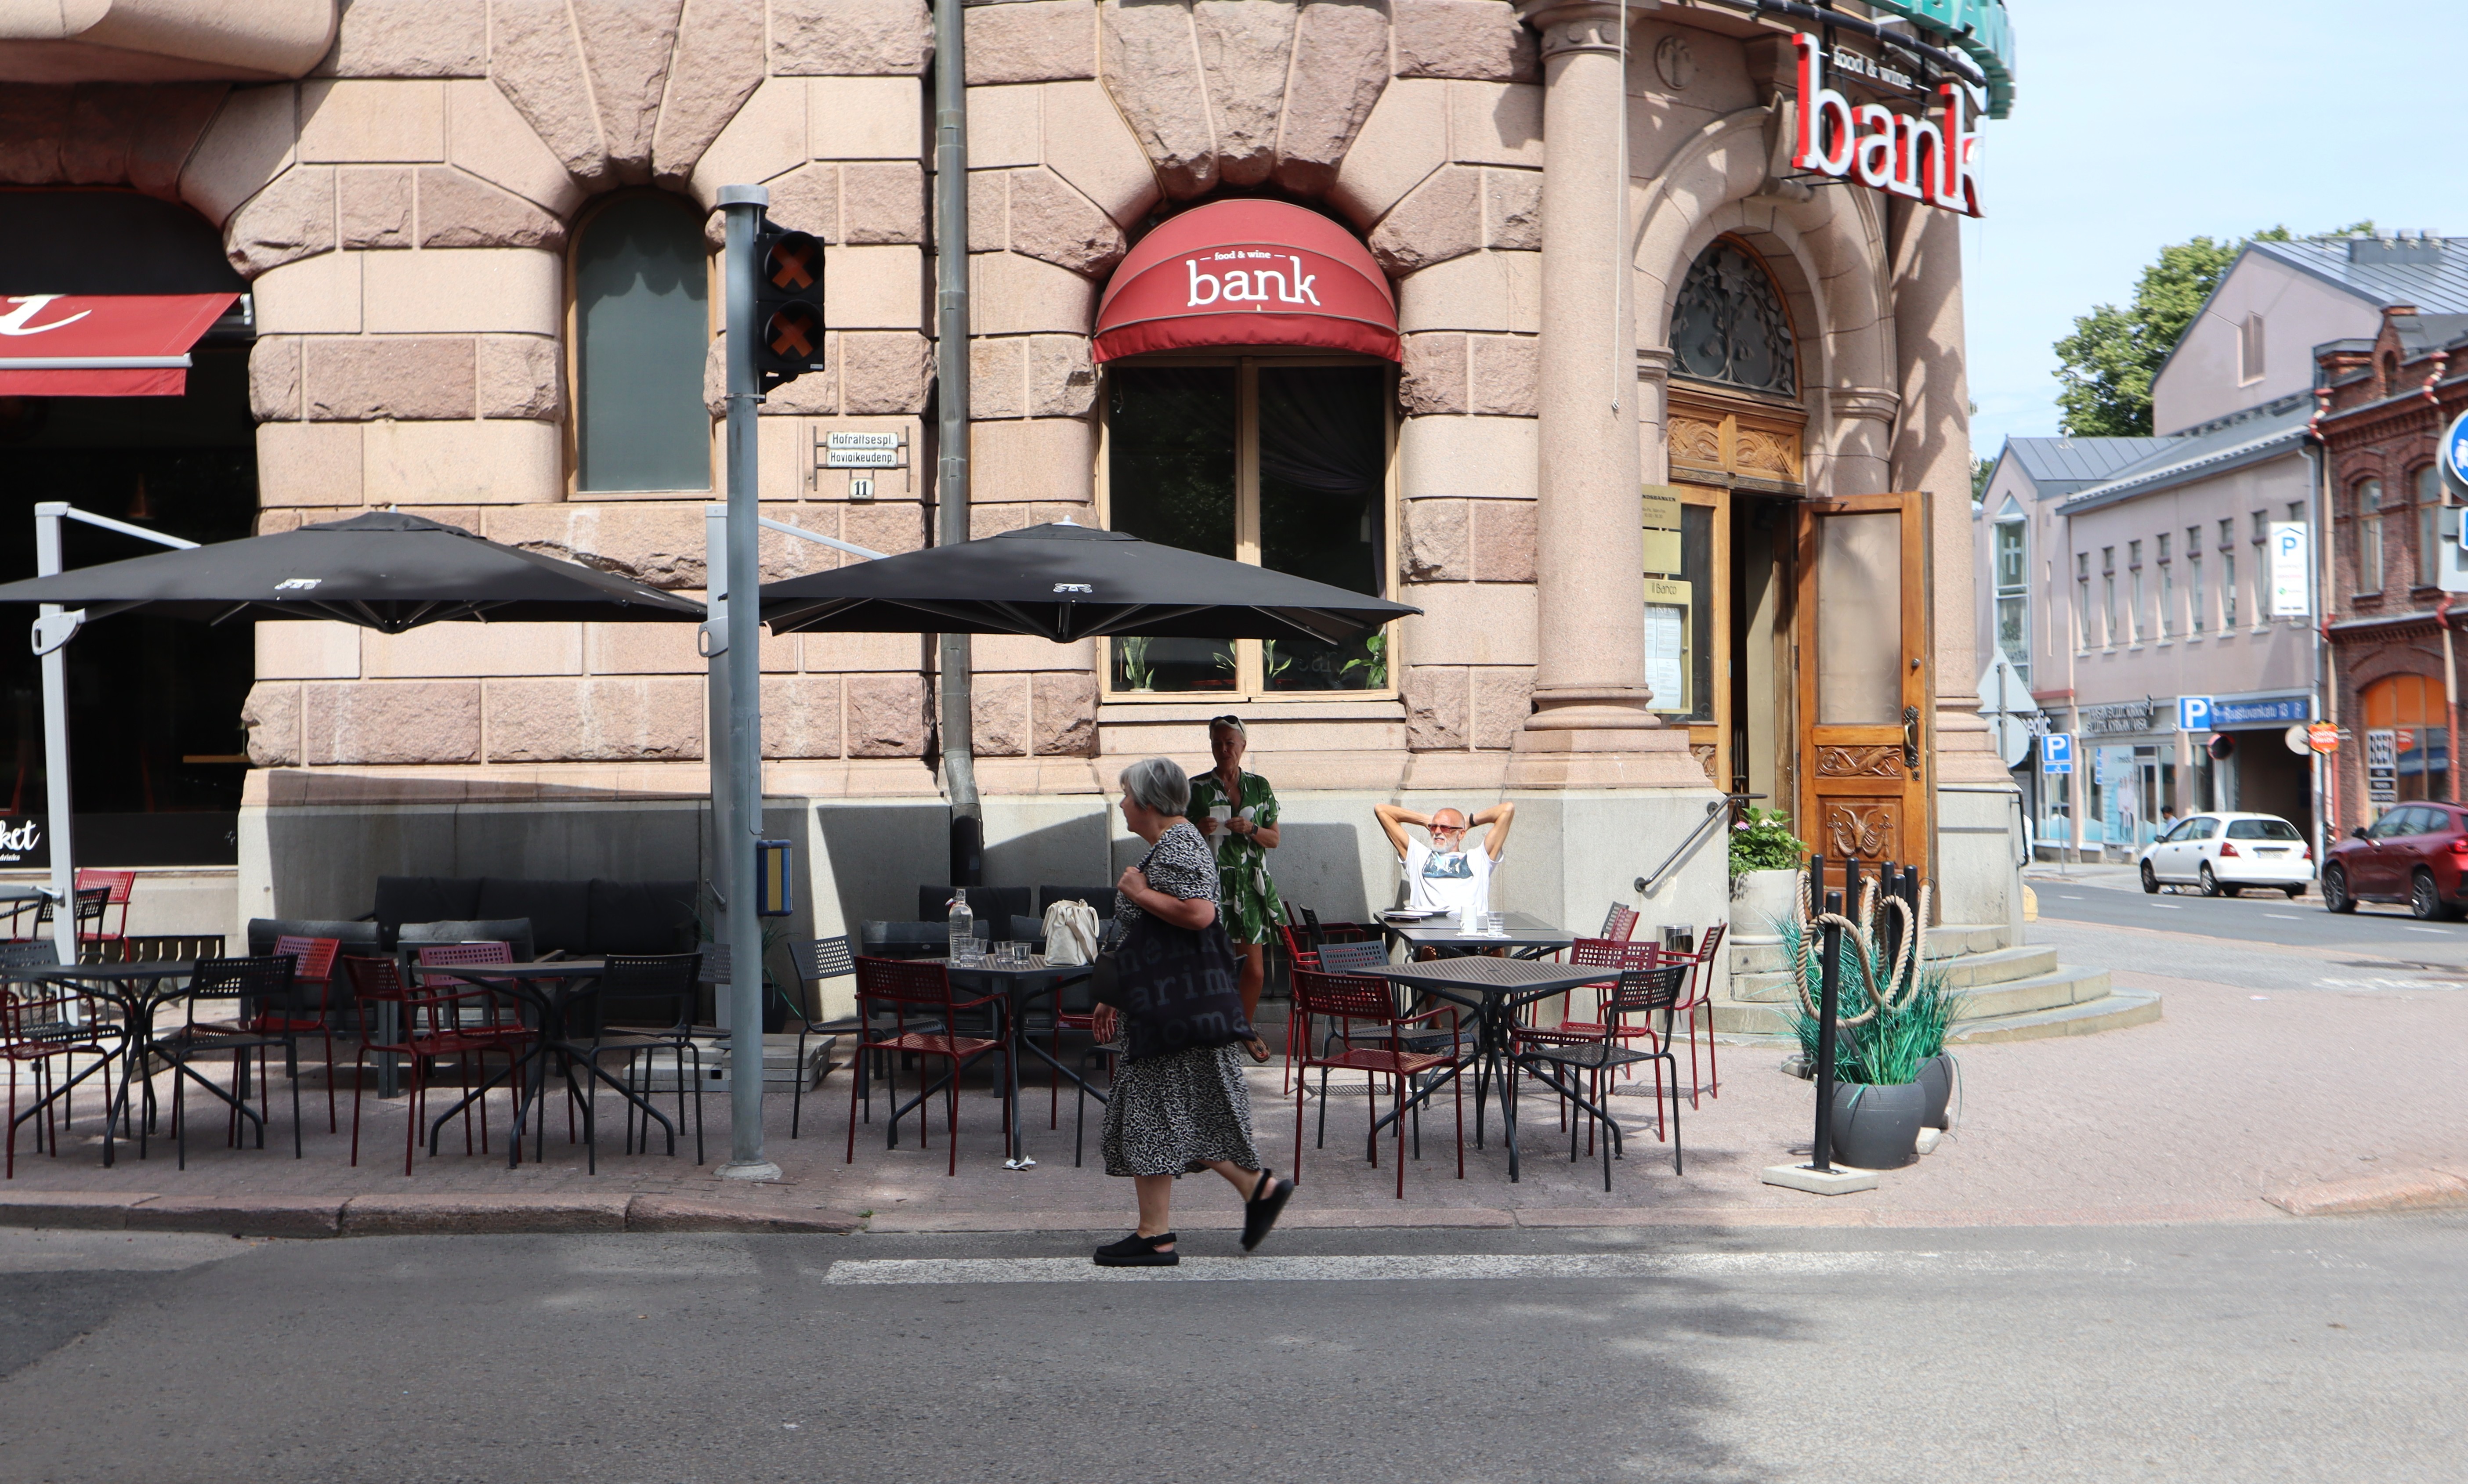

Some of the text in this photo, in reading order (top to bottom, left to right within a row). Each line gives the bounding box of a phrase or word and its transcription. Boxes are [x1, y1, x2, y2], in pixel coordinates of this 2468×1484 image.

[1834, 46, 1912, 90] food & wine
[1792, 32, 1987, 218] bank
[1214, 250, 1271, 260] food & wine
[1186, 256, 1321, 307] bank
[831, 452, 894, 464] Hovioikeudenp.
[854, 480, 868, 496] 11
[2282, 537, 2297, 556] P
[1656, 583, 1677, 595] Banco
[2185, 699, 2208, 728] P
[2047, 737, 2066, 760] P
